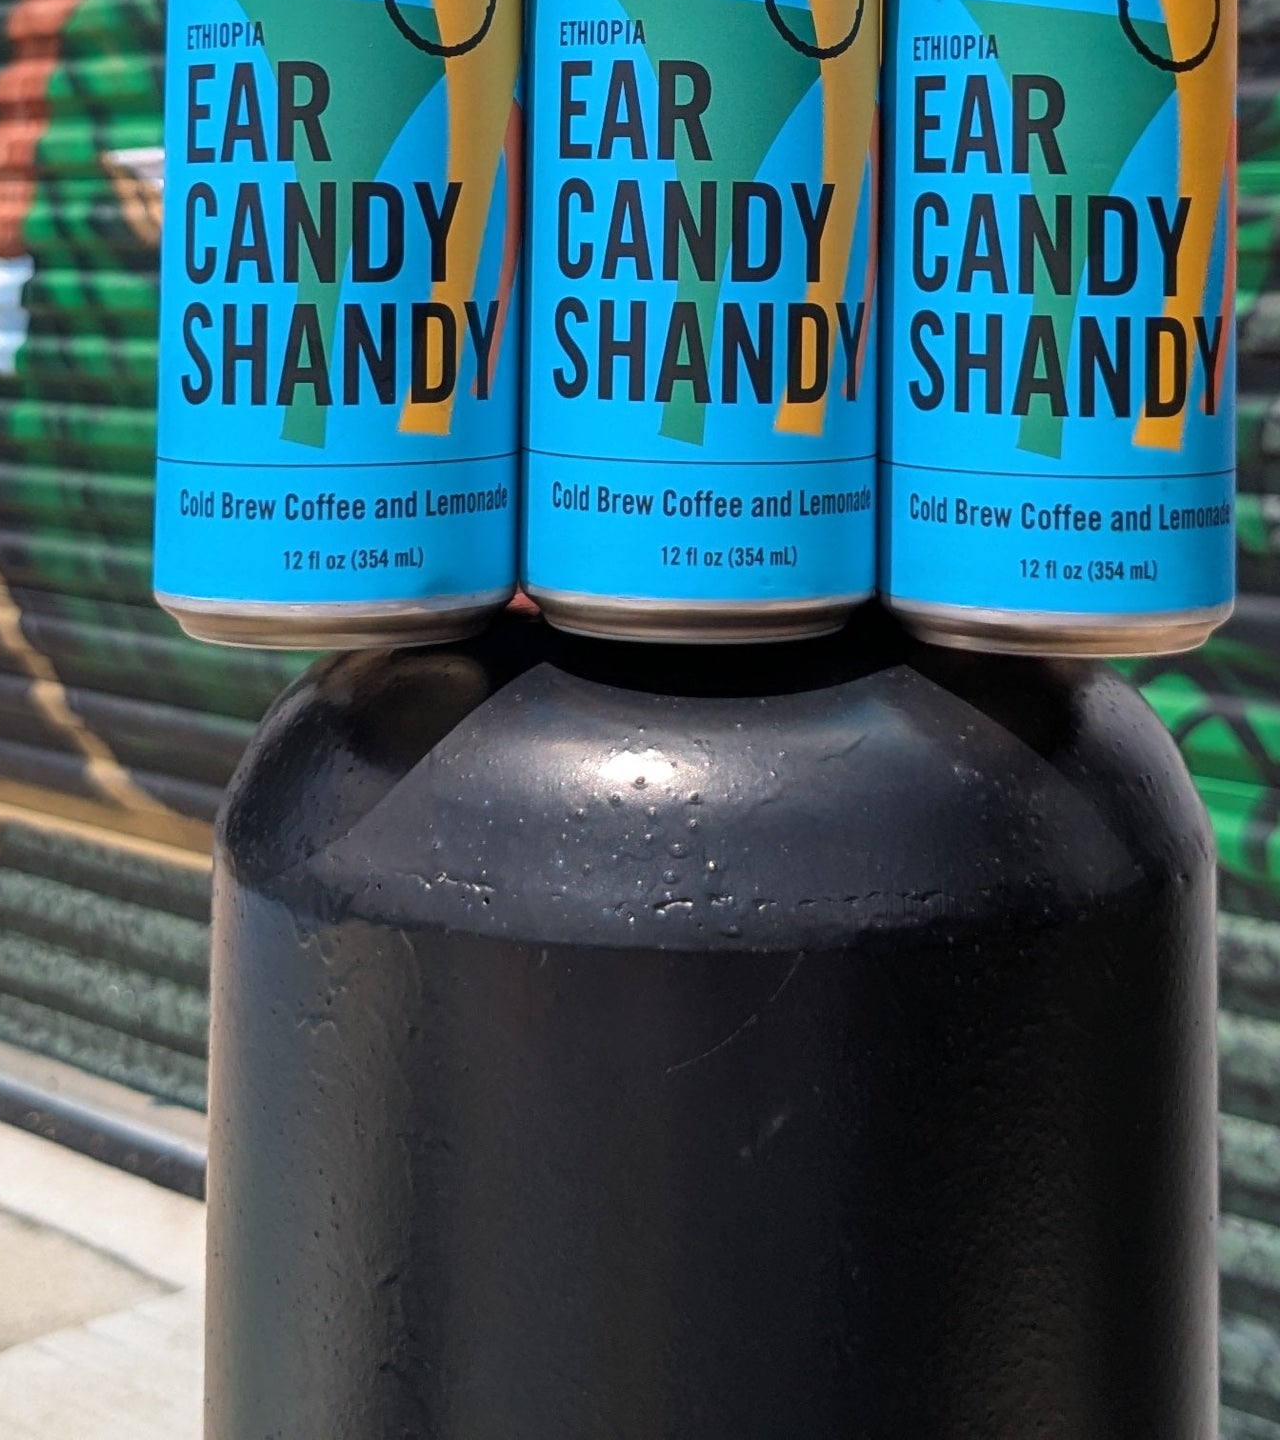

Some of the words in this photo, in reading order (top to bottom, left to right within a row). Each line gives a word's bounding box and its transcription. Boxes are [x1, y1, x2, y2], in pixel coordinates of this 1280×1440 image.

[187, 21, 265, 50] ETHIOPIA
[560, 19, 646, 46] ETHIOPIA
[913, 34, 999, 61] ETHIOPIA
[186, 60, 332, 164] EAR
[559, 59, 712, 160] EAR
[913, 74, 1067, 175] EAR
[185, 181, 463, 284] CANDY
[558, 177, 836, 283] CANDY
[912, 191, 1192, 297] CANDY
[181, 300, 500, 406] SHANDY
[552, 296, 865, 404] SHANDY
[909, 309, 1223, 418] SHANDY
[180, 488, 214, 518] Cold
[222, 493, 276, 520] Brew
[285, 493, 365, 520] Coffee
[375, 490, 417, 519] and
[425, 482, 508, 516] Lemonade
[552, 481, 589, 511] Cold
[597, 486, 654, 515] Brew
[663, 489, 743, 518] Coffee
[751, 490, 792, 517] and
[800, 484, 872, 516] Lemonade
[910, 492, 947, 523] Cold
[955, 498, 1012, 528] Brew
[1021, 502, 1102, 531] Coffee
[1110, 504, 1151, 531] and
[283, 550, 302, 570] 12
[308, 550, 320, 570] fl
[326, 553, 345, 569] oz
[351, 549, 388, 571] (354
[394, 547, 424, 569] mL)
[661, 546, 680, 566] 12
[686, 546, 697, 566] fl
[703, 550, 723, 566] oz
[727, 546, 764, 569] (354
[770, 545, 798, 567] mL)
[1020, 559, 1039, 579] 12
[1045, 559, 1057, 579] fl
[1063, 564, 1082, 580] oz
[1087, 560, 1124, 583] (354
[1129, 560, 1158, 581] mL)
